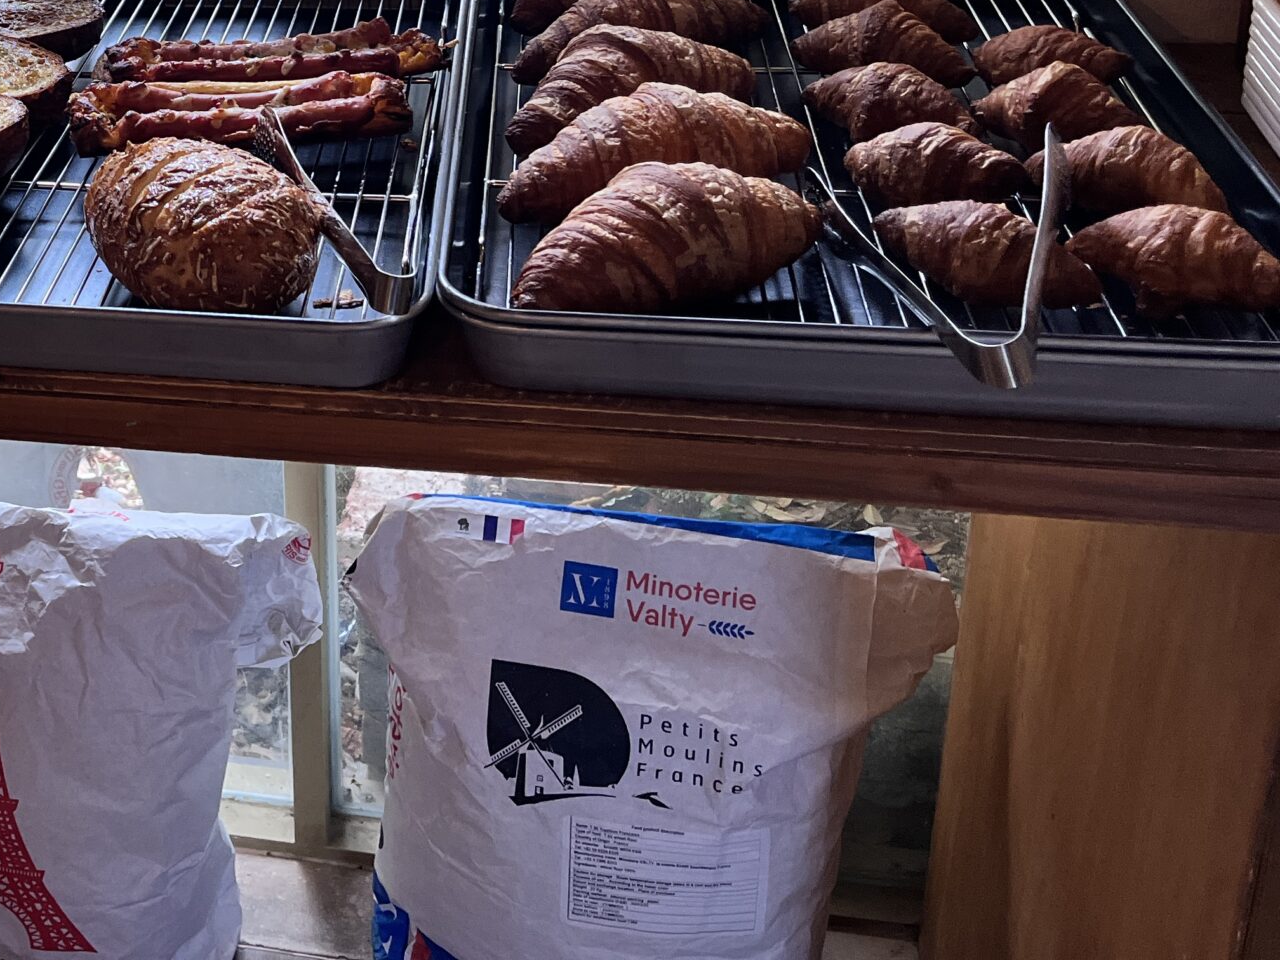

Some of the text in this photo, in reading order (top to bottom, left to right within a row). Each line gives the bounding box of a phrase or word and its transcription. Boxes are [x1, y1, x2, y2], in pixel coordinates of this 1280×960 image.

[626, 570, 757, 611] Minoterie
[626, 598, 694, 637] Valty
[640, 713, 738, 747] Petits
[638, 737, 763, 778] Moulins
[636, 762, 743, 795] France
